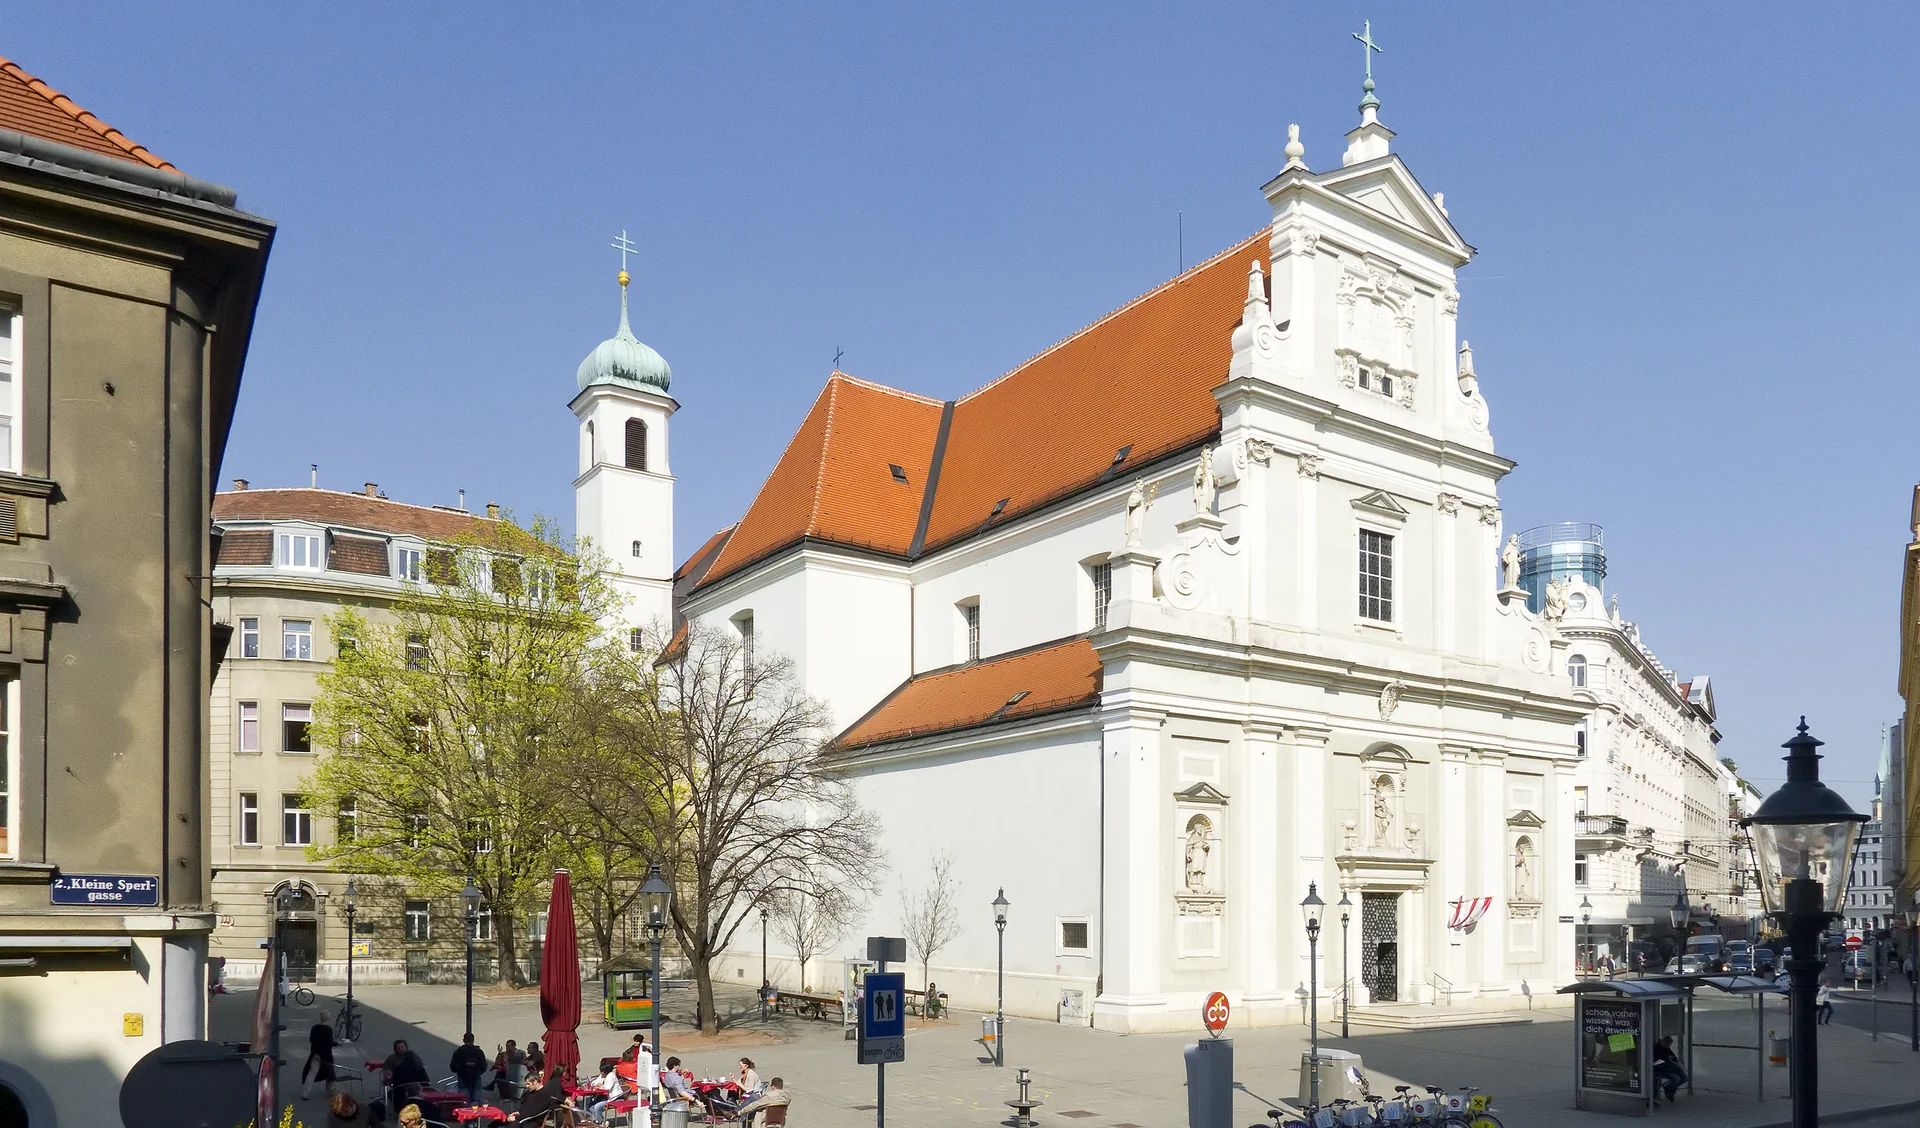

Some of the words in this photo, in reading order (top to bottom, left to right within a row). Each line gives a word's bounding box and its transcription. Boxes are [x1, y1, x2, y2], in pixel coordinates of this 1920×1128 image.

[118, 880, 155, 892] Sperl-
[88, 892, 122, 901] gasse
[1611, 1010, 1639, 1019] vorher
[1614, 1019, 1630, 1027] was
